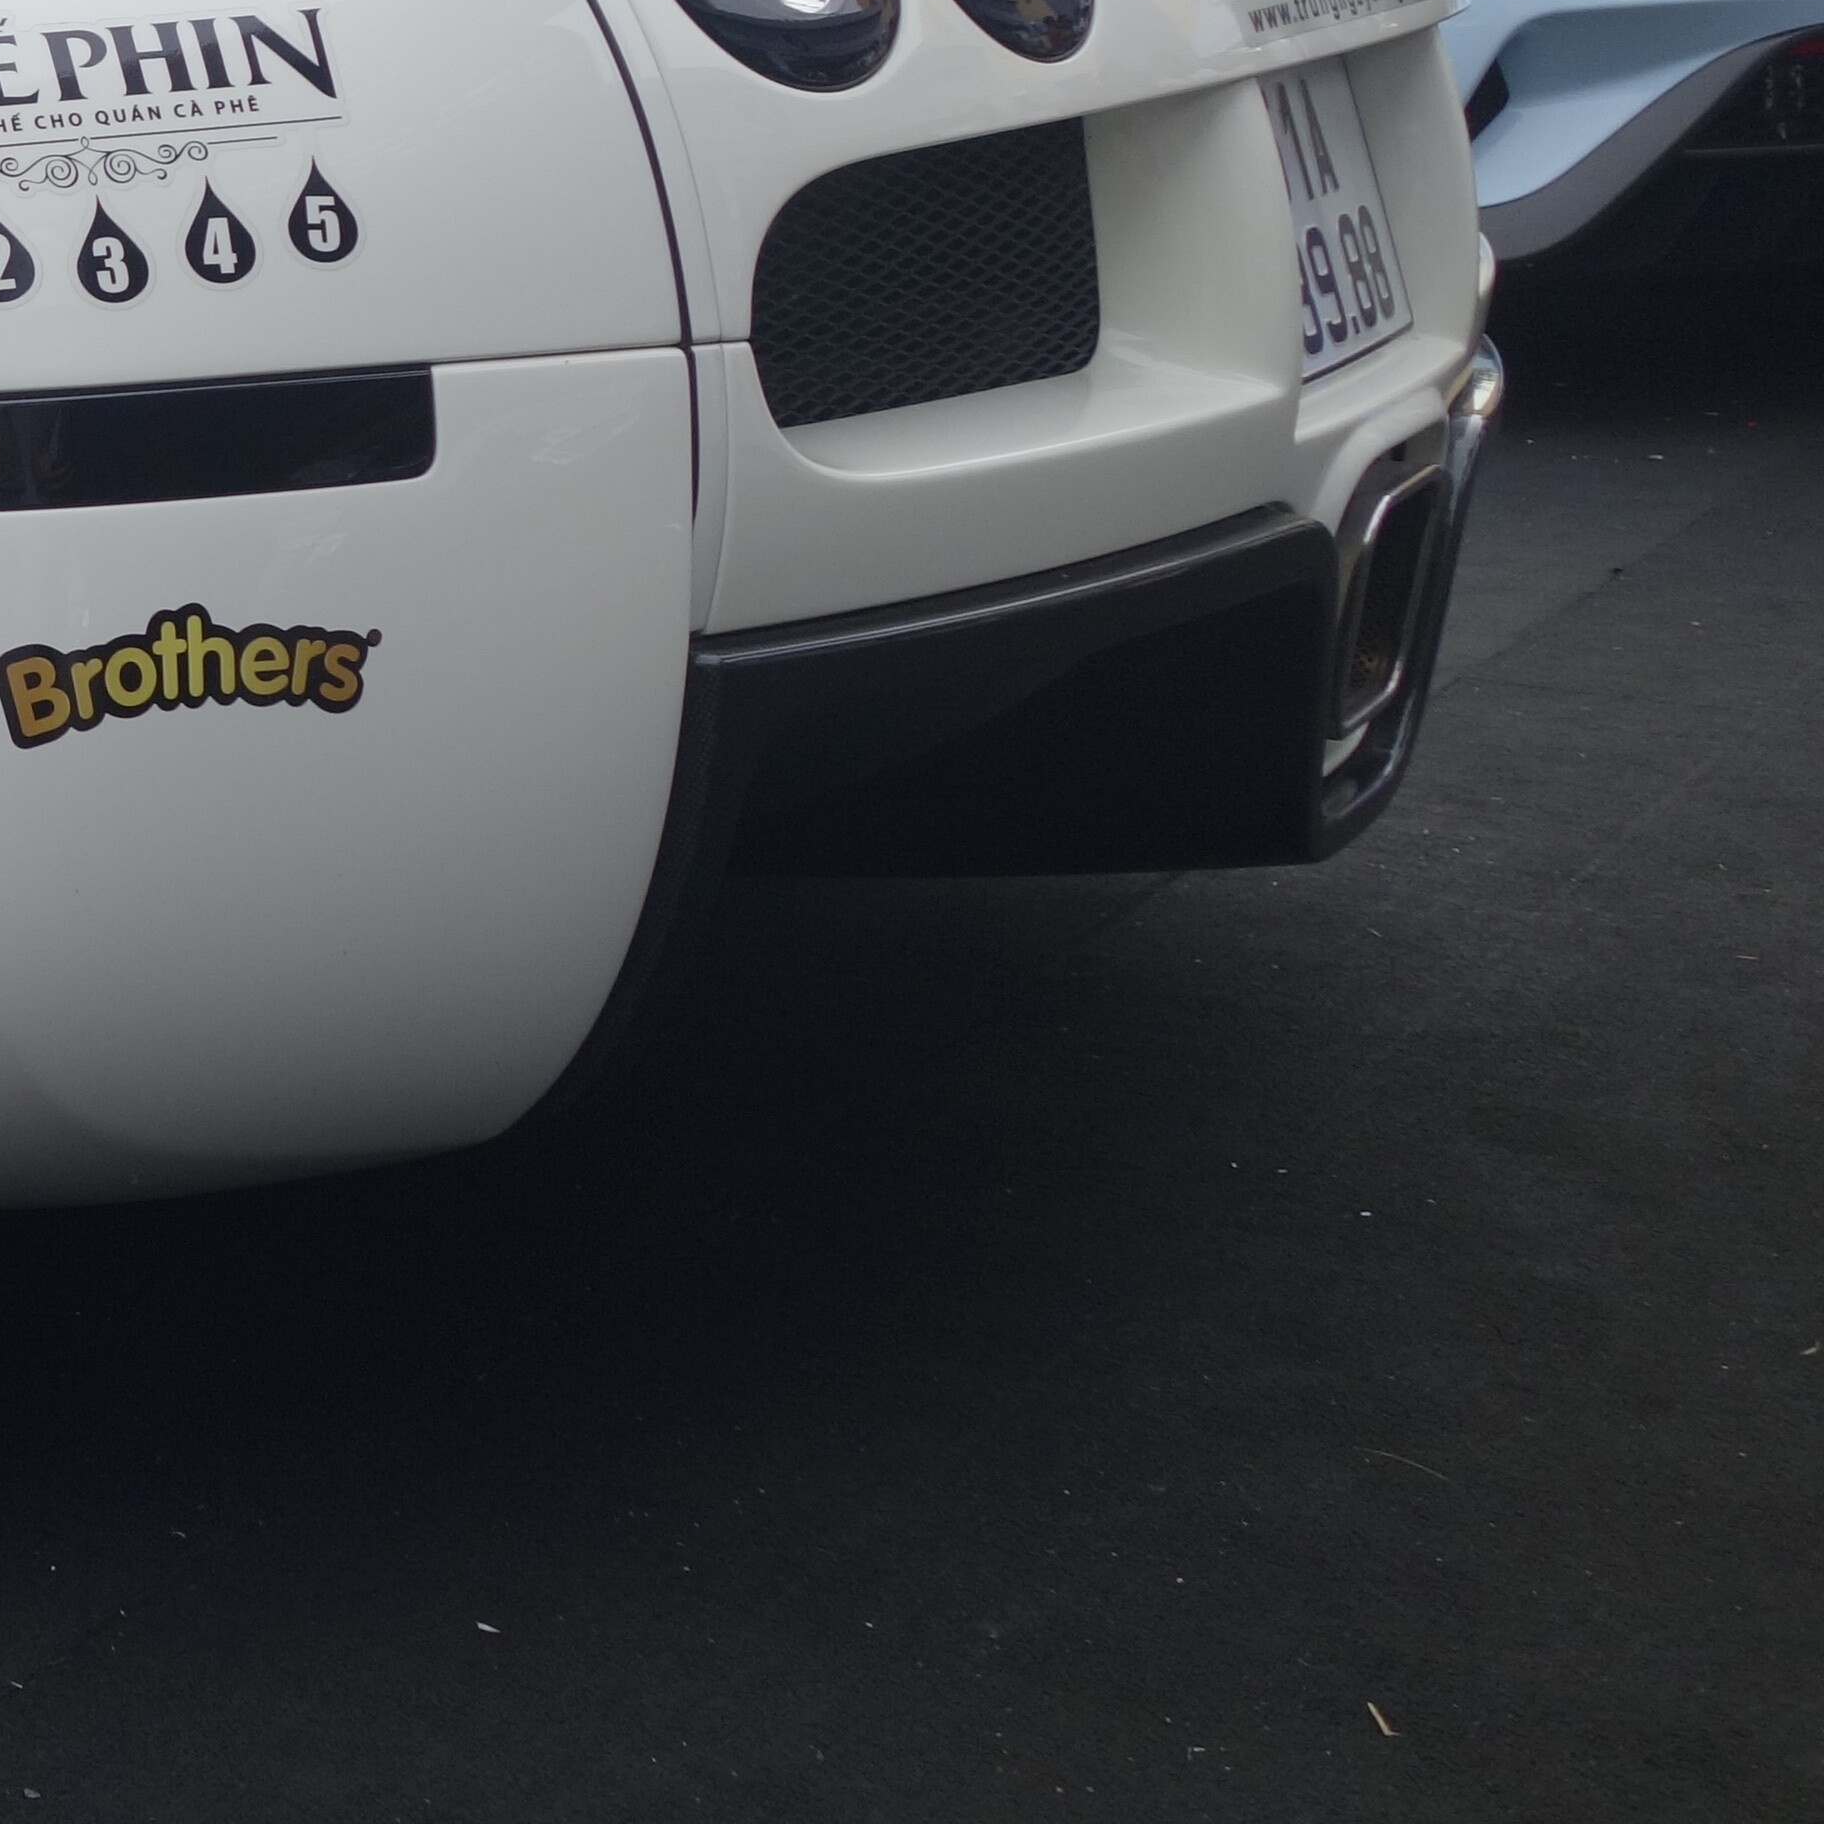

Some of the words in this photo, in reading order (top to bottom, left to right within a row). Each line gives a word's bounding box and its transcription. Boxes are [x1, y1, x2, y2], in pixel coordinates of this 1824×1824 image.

[40, 7, 338, 102] PHIN
[34, 111, 83, 131] CHO
[95, 104, 162, 126] QUÁN
[174, 98, 204, 118] CÀ
[215, 94, 260, 116] PHÊ
[1260, 78, 1340, 204] 1A
[92, 237, 129, 293] 3
[202, 216, 237, 274] 4
[304, 195, 342, 252] 5
[5, 613, 362, 738] Brothers
